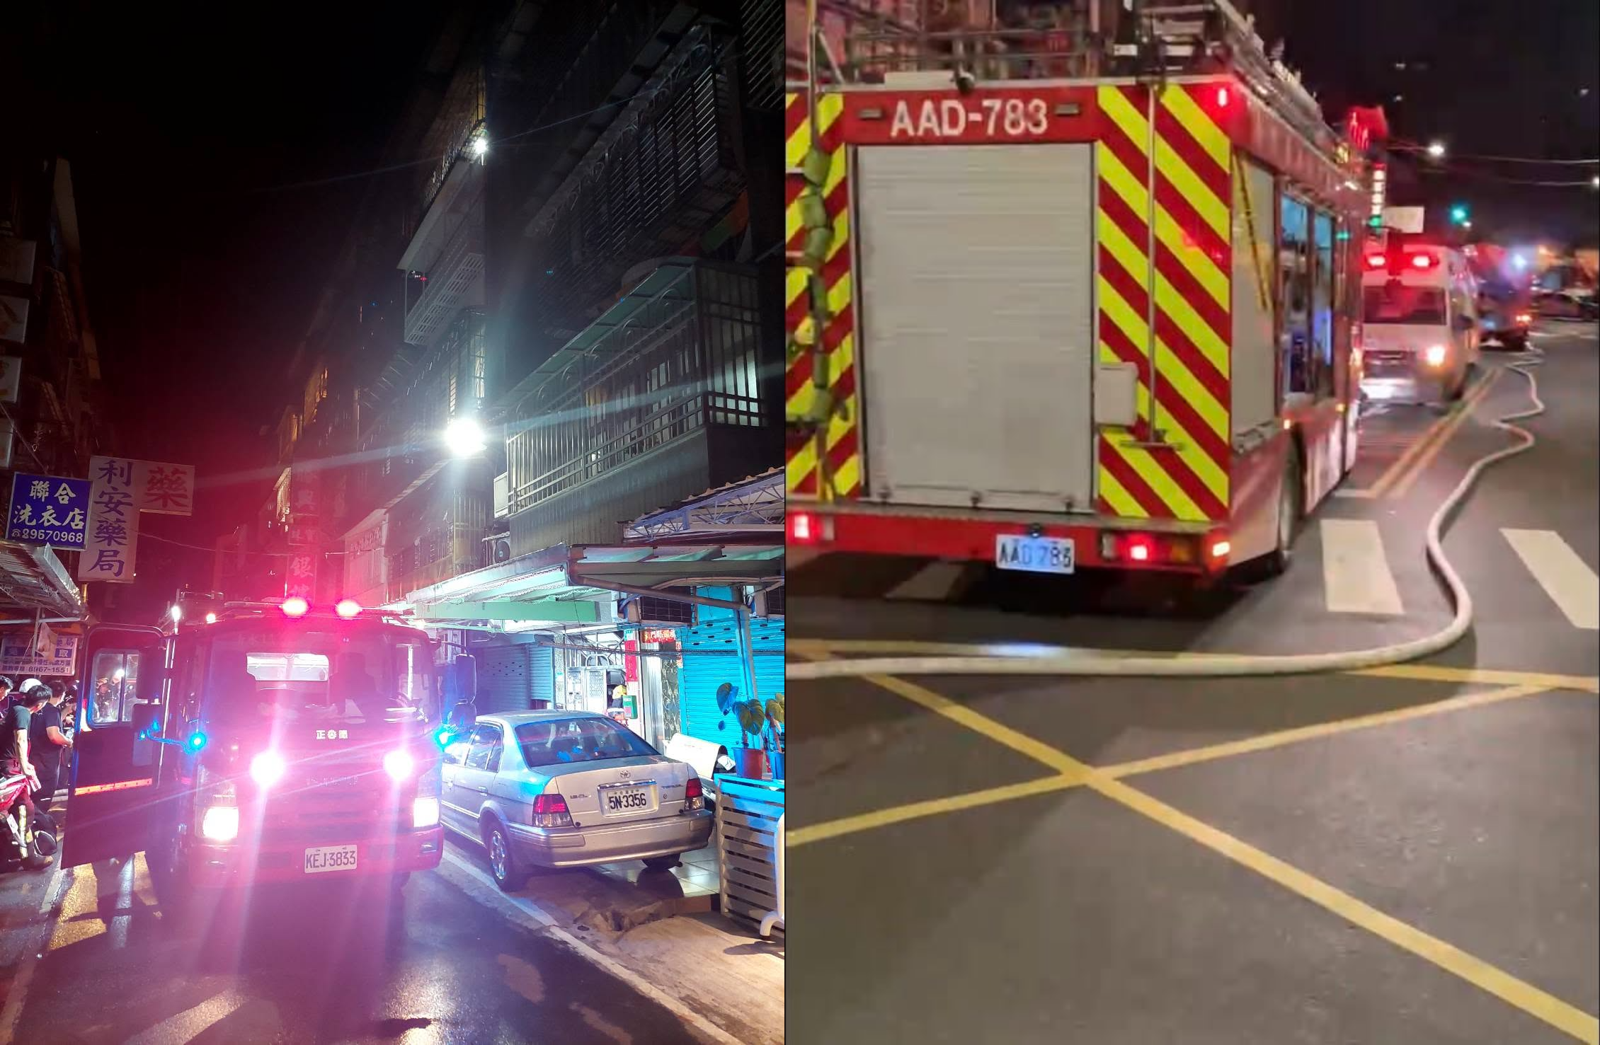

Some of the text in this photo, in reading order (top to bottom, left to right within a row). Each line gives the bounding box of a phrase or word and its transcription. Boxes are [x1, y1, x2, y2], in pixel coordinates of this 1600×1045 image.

[890, 98, 1048, 138] AAD-783
[29, 480, 76, 504] 聯合
[144, 466, 189, 508] 藥
[13, 503, 85, 530] 洗衣店
[88, 459, 134, 578] 利安藥局
[22, 528, 83, 543] 89670968
[608, 793, 647, 810] 5N-3356
